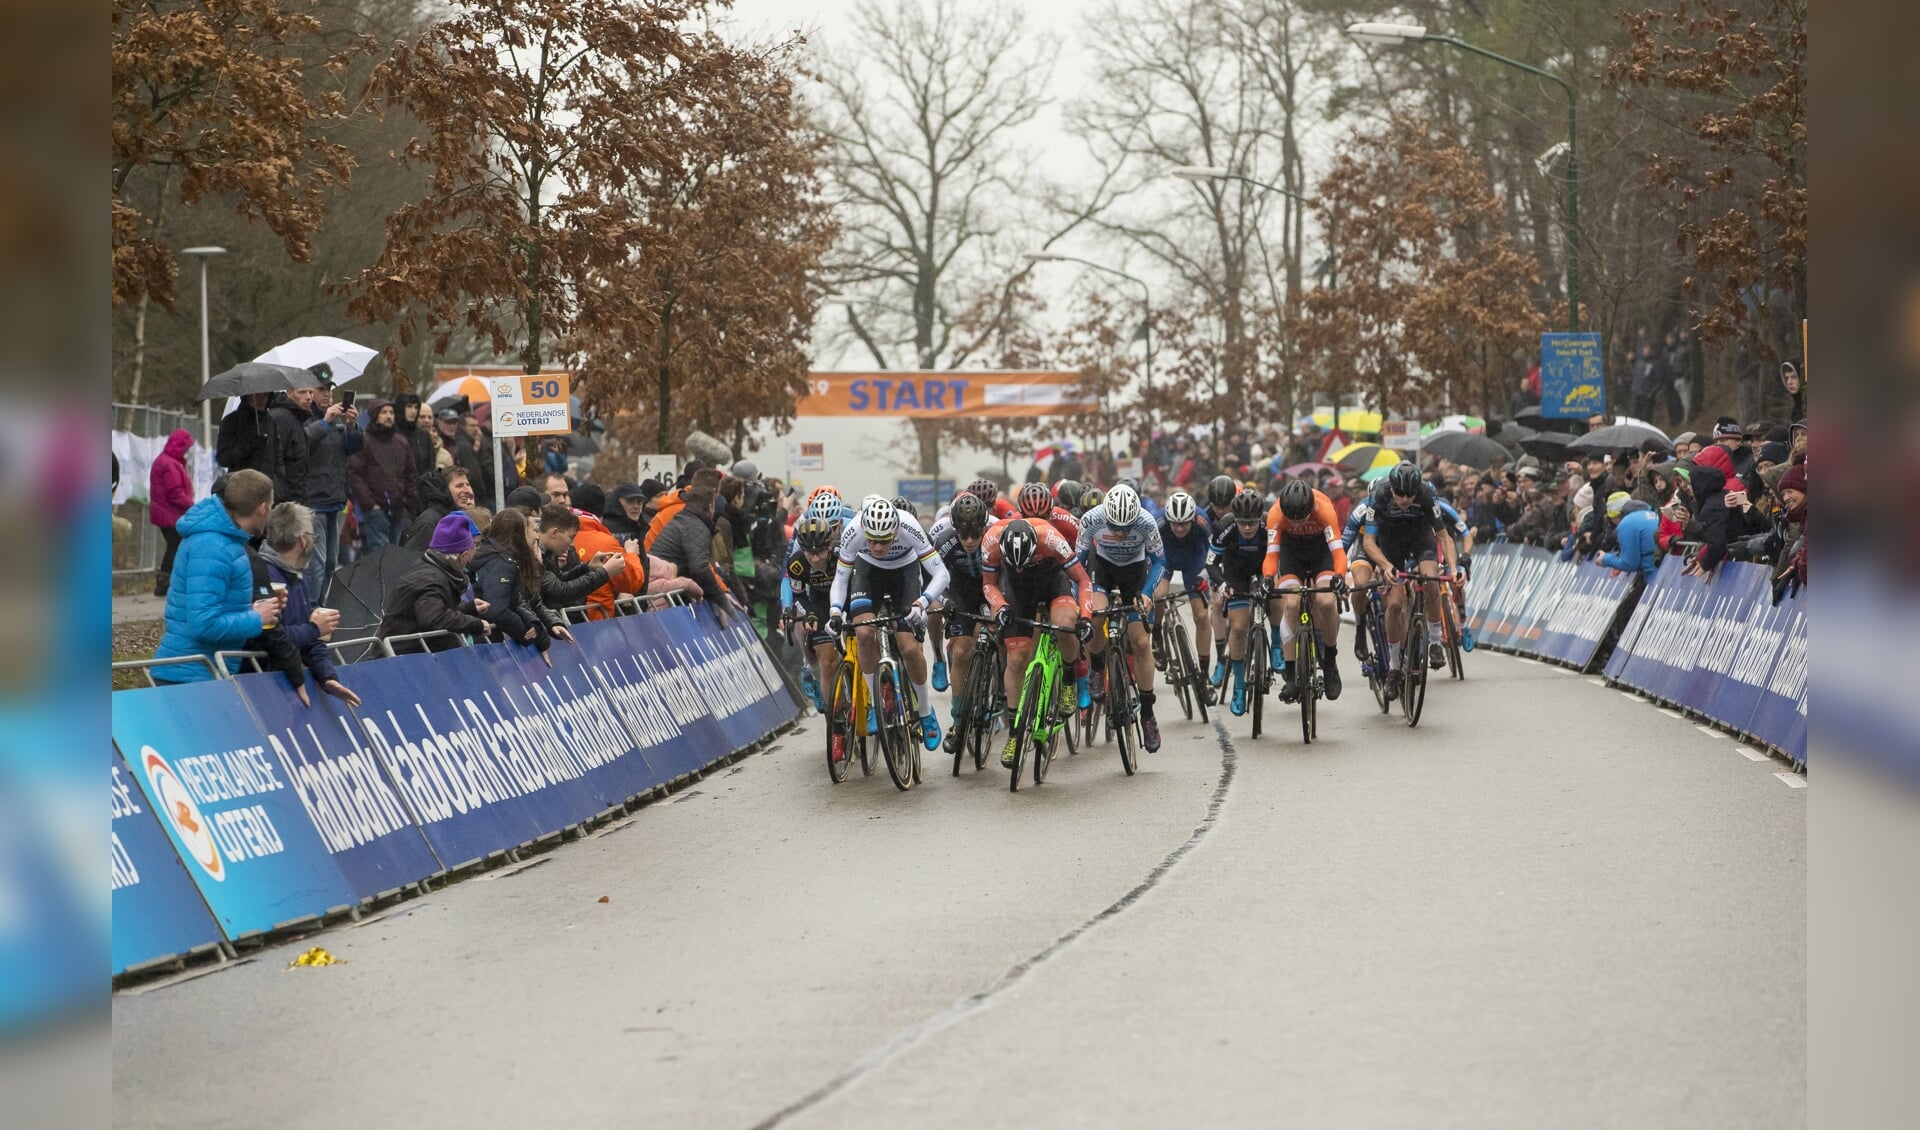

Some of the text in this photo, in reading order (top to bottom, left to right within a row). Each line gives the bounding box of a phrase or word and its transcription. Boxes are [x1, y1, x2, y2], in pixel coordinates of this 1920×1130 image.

[531, 380, 560, 399] 50
[848, 380, 970, 411] START
[516, 409, 566, 418] NEDERLANDSE
[517, 418, 550, 426] LOTERIJ
[267, 715, 412, 855] Rabobank
[362, 698, 515, 826] Rabobank
[464, 686, 584, 798] Rabobank
[533, 664, 635, 772] Rabobank
[593, 655, 682, 749] Rabobank
[174, 745, 285, 805] NEDERLANDSE
[204, 804, 285, 863] LOTERIJ
